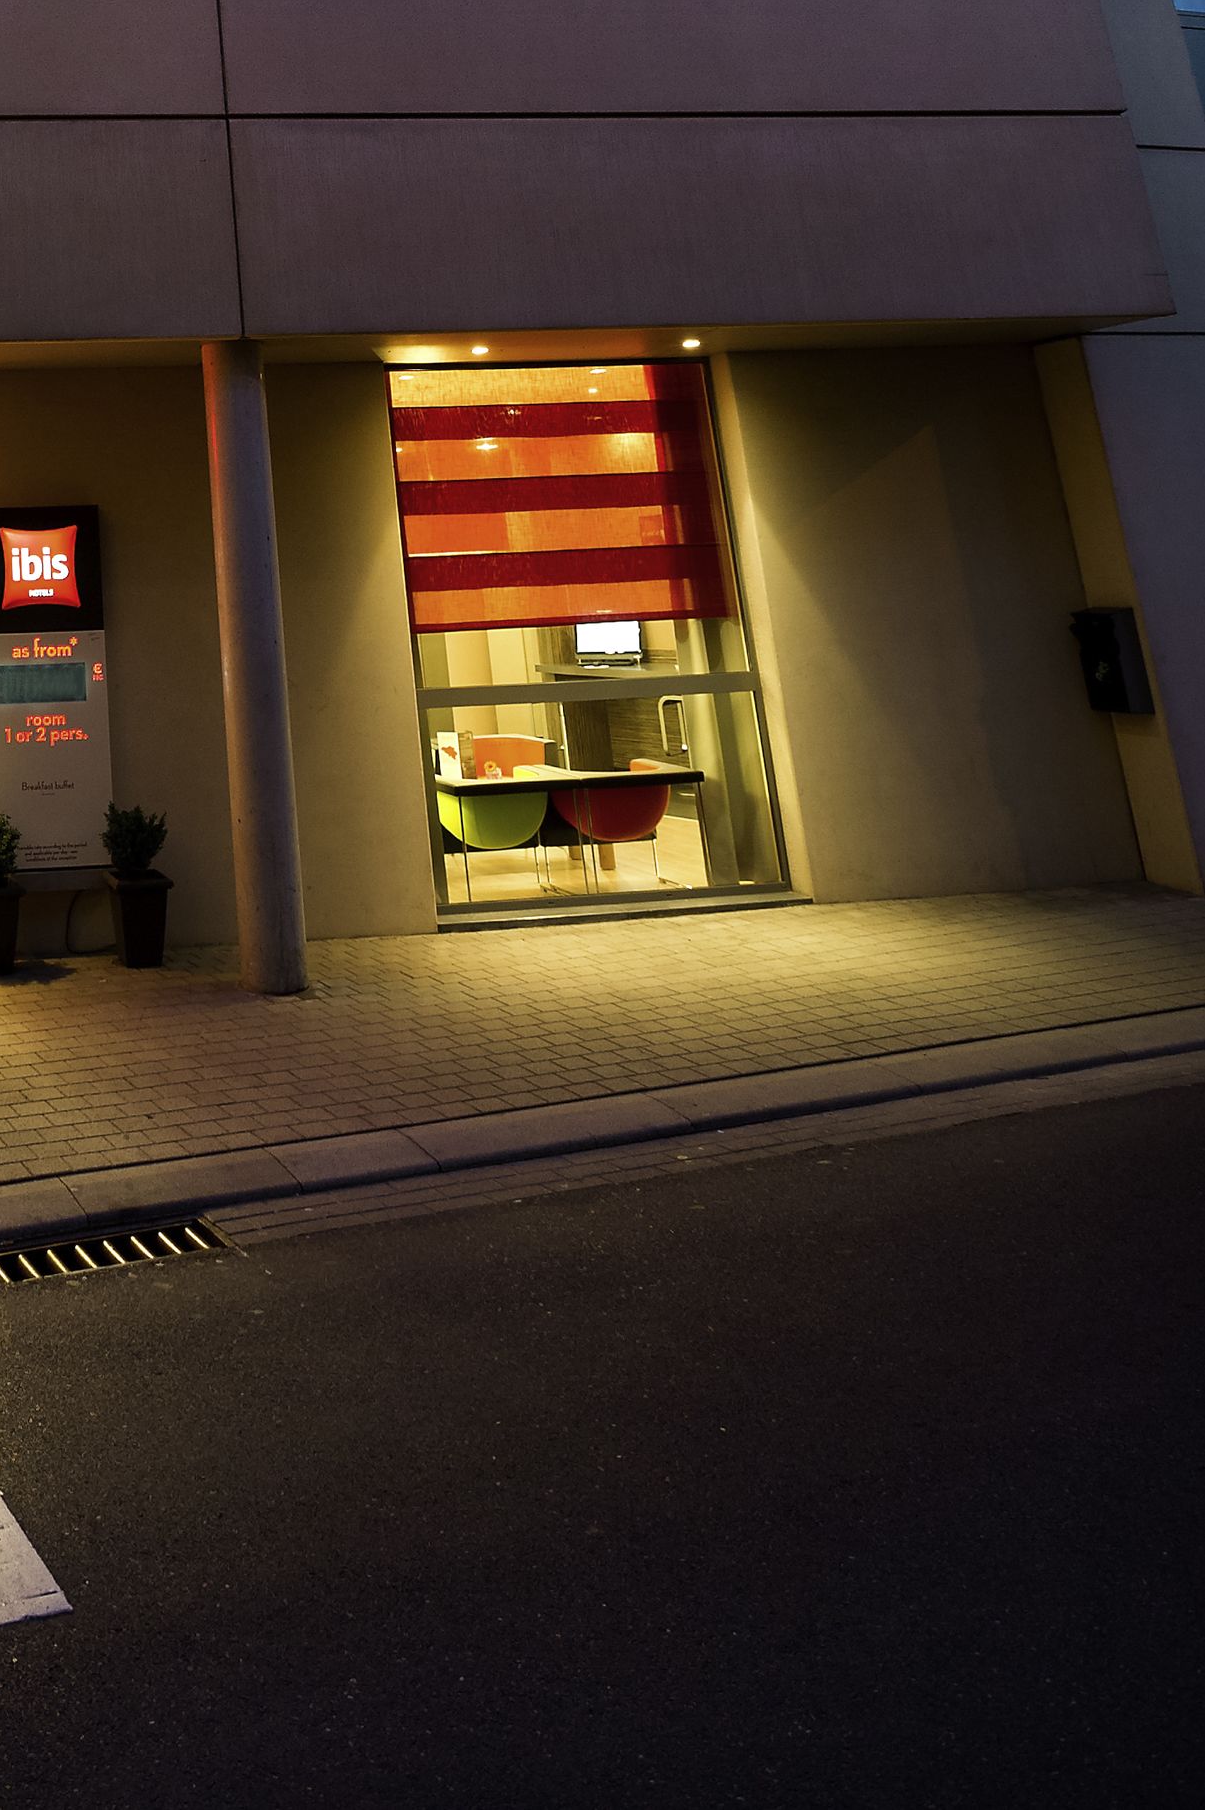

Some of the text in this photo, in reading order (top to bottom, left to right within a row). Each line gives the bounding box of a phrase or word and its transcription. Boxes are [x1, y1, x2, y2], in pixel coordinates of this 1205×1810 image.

[11, 547, 69, 582] ibis
[12, 647, 30, 659] as
[26, 714, 67, 727] room
[4, 726, 90, 747] 1 or 2 pers.
[22, 779, 75, 791] Breakfast buffet
